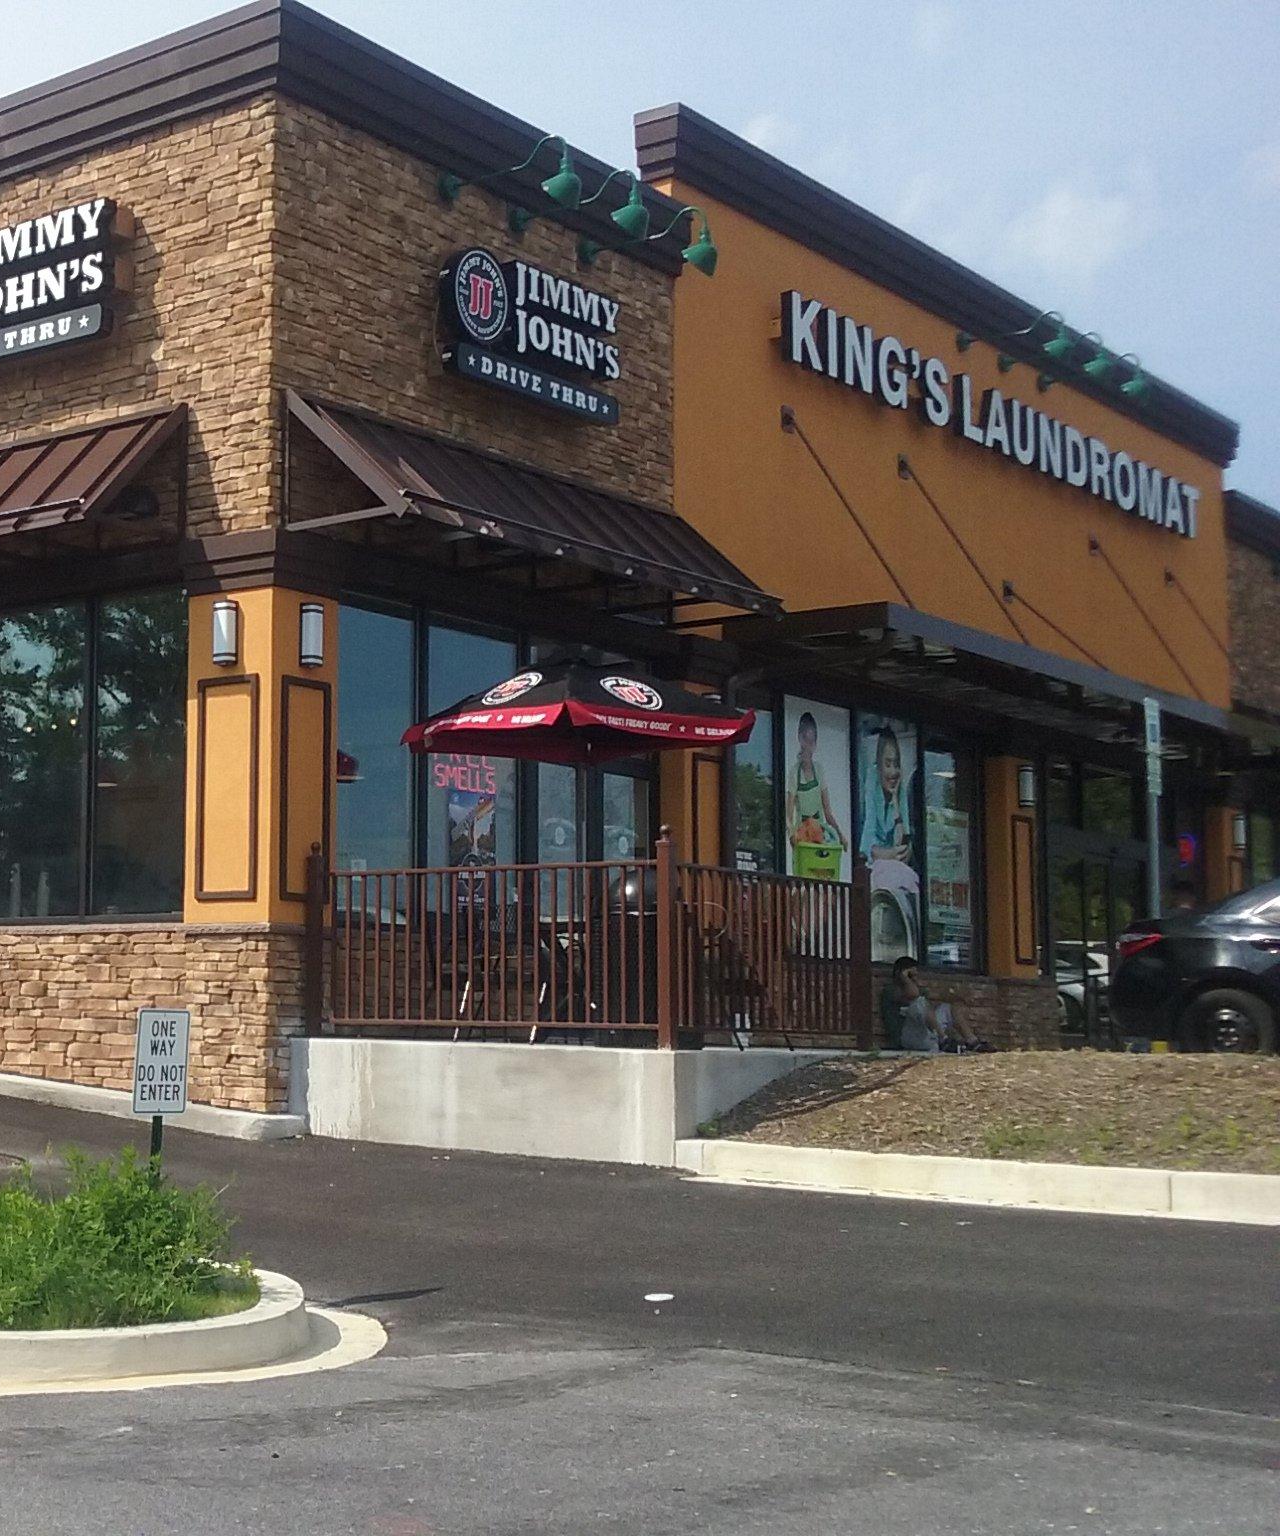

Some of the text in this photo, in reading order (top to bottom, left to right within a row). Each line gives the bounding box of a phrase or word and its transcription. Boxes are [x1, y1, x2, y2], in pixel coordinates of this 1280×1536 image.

[469, 273, 494, 320] JJ
[515, 262, 619, 333] JIMMY
[4, 316, 72, 350] THRU
[516, 309, 620, 380] JOHN'S
[481, 356, 598, 413] DRIVE THRU
[790, 290, 1200, 539] KING'S LAUNDROMAT
[434, 763, 497, 795] SMELLS
[151, 1020, 177, 1037] ONE
[150, 1040, 176, 1056] WAY
[138, 1064, 185, 1081] DO NOT
[140, 1084, 180, 1101] ENTER
